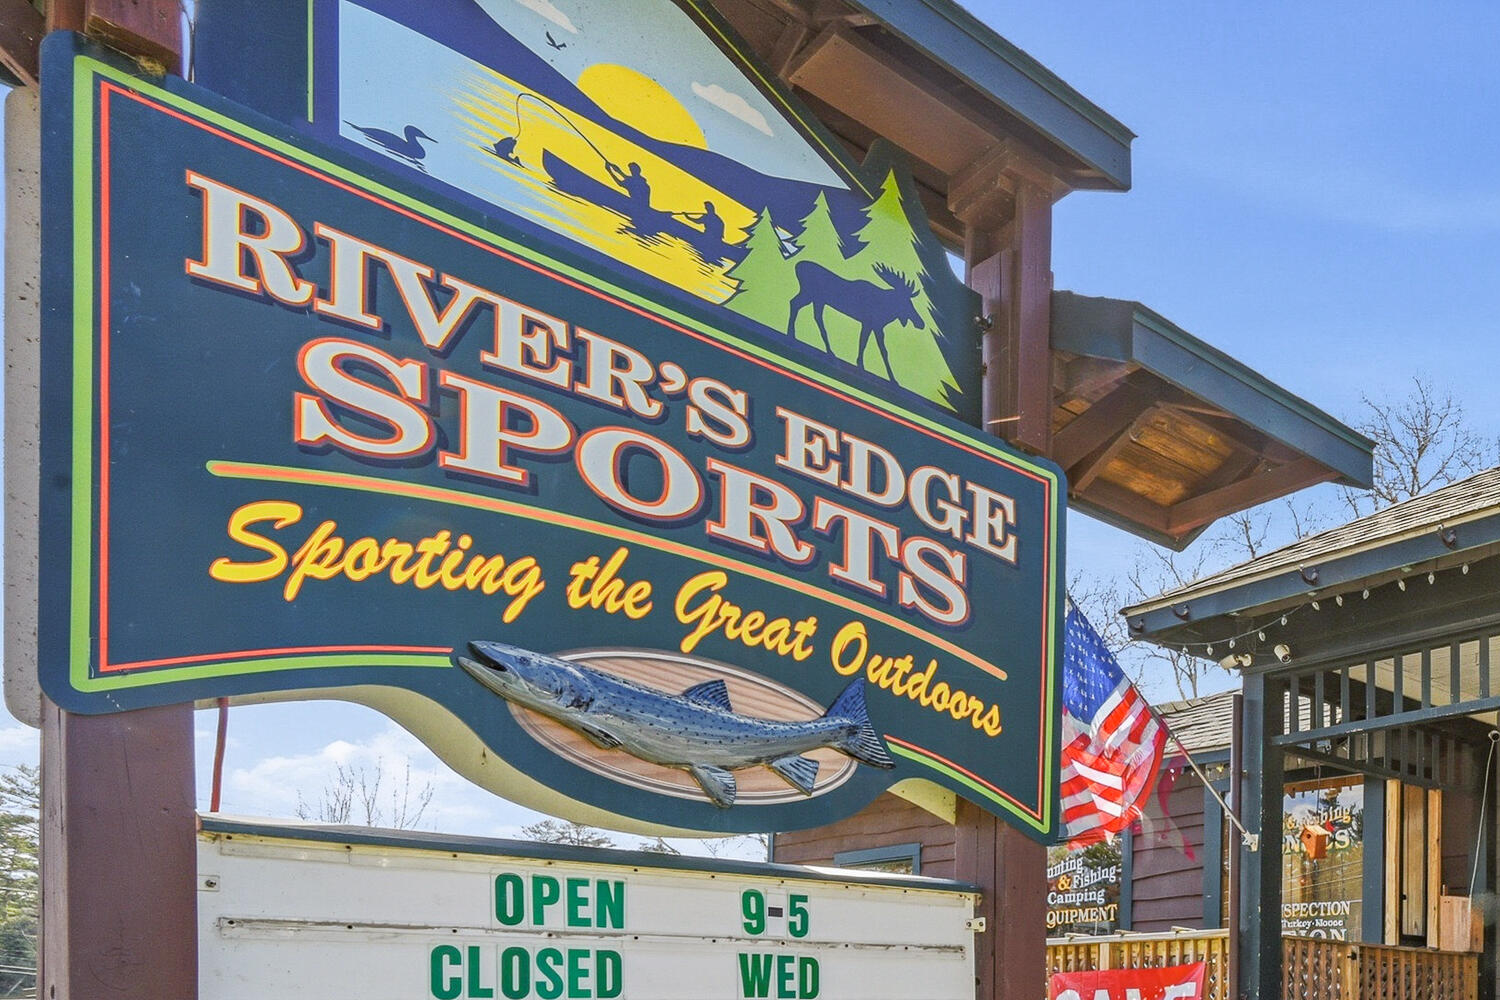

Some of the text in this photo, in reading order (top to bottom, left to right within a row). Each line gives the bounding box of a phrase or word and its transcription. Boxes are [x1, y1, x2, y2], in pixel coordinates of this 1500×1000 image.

[186, 169, 1018, 564] RIVER'S EDGE
[294, 337, 970, 627] SPORTS
[209, 500, 1004, 738] Sporting the Great Outdoors
[1047, 856, 1083, 875] unting
[1058, 865, 1117, 890] & Fishing
[494, 872, 809, 938] OPEN 9-5
[1046, 903, 1118, 928] QUIPMENT
[1047, 888, 1106, 905] Camping
[1282, 901, 1351, 918] SPECTION
[429, 944, 820, 1000] CLOSED WED
